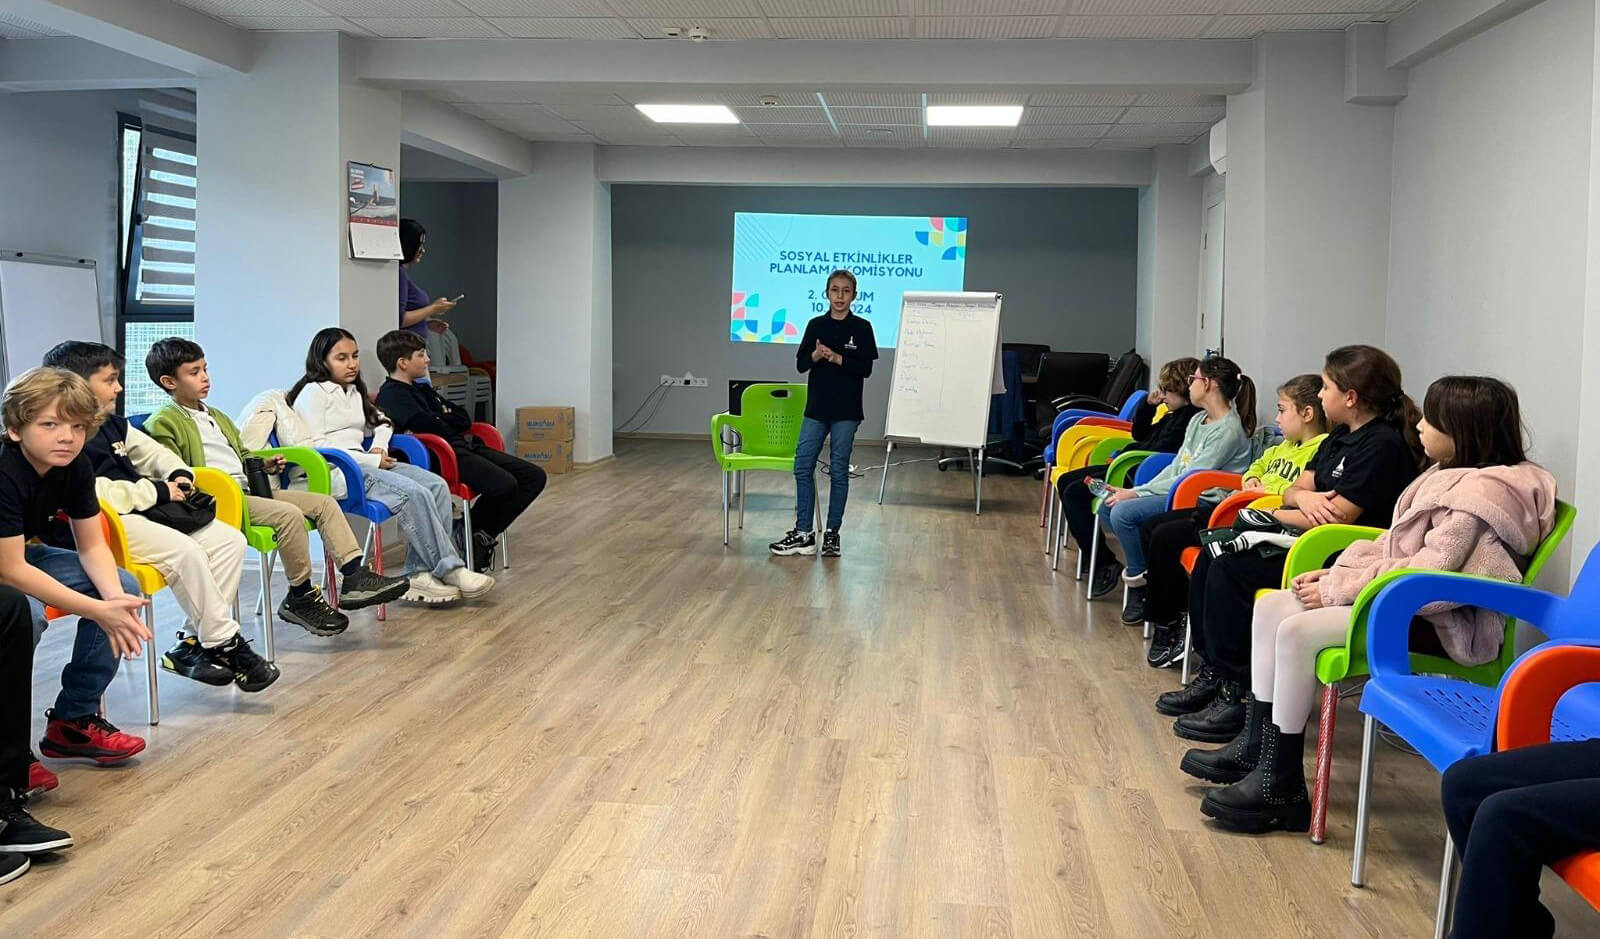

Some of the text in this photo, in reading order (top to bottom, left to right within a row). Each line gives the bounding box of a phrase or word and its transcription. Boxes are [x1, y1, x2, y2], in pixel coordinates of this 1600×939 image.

[780, 250, 913, 264] SOSYAL ETKİNLİKLER
[808, 289, 817, 300] 2.
